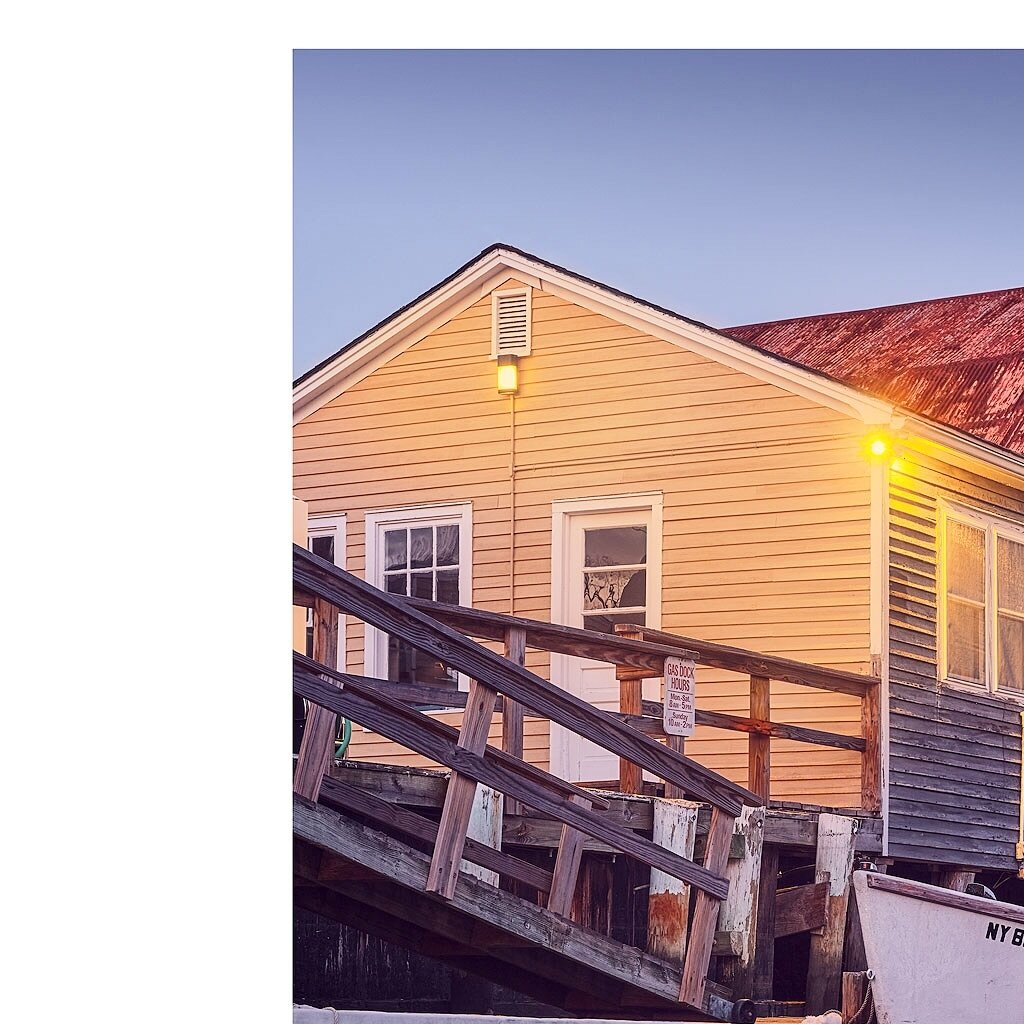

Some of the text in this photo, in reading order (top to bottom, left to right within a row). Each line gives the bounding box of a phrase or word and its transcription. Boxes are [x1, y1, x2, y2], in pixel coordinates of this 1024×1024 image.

[668, 664, 694, 679] GAS DOCK
[671, 677, 689, 691] HOURS
[672, 712, 689, 721] Sunday
[985, 922, 1011, 942] NY
